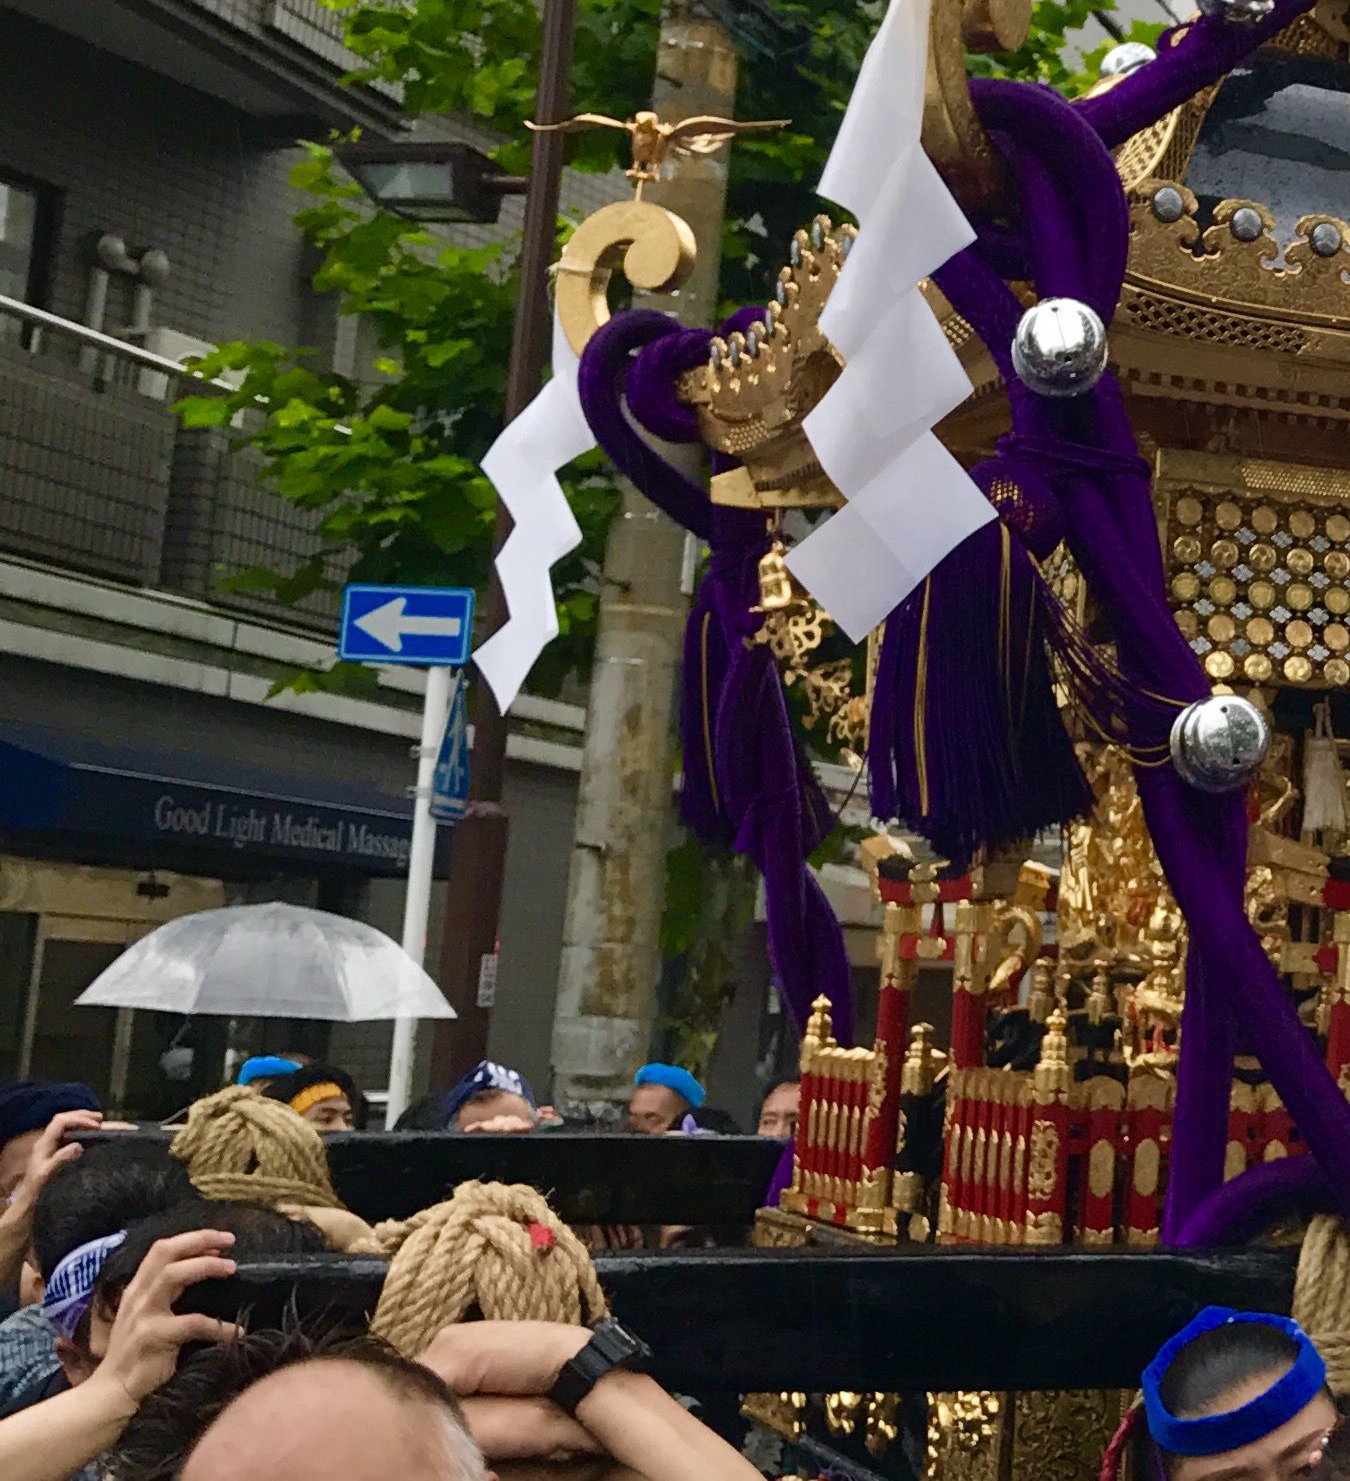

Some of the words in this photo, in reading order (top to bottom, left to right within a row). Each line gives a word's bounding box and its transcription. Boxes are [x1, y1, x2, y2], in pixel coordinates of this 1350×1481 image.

[155, 795, 211, 835] Good
[214, 804, 266, 848] Light
[271, 813, 344, 852] Medical
[347, 824, 412, 868] Massag
